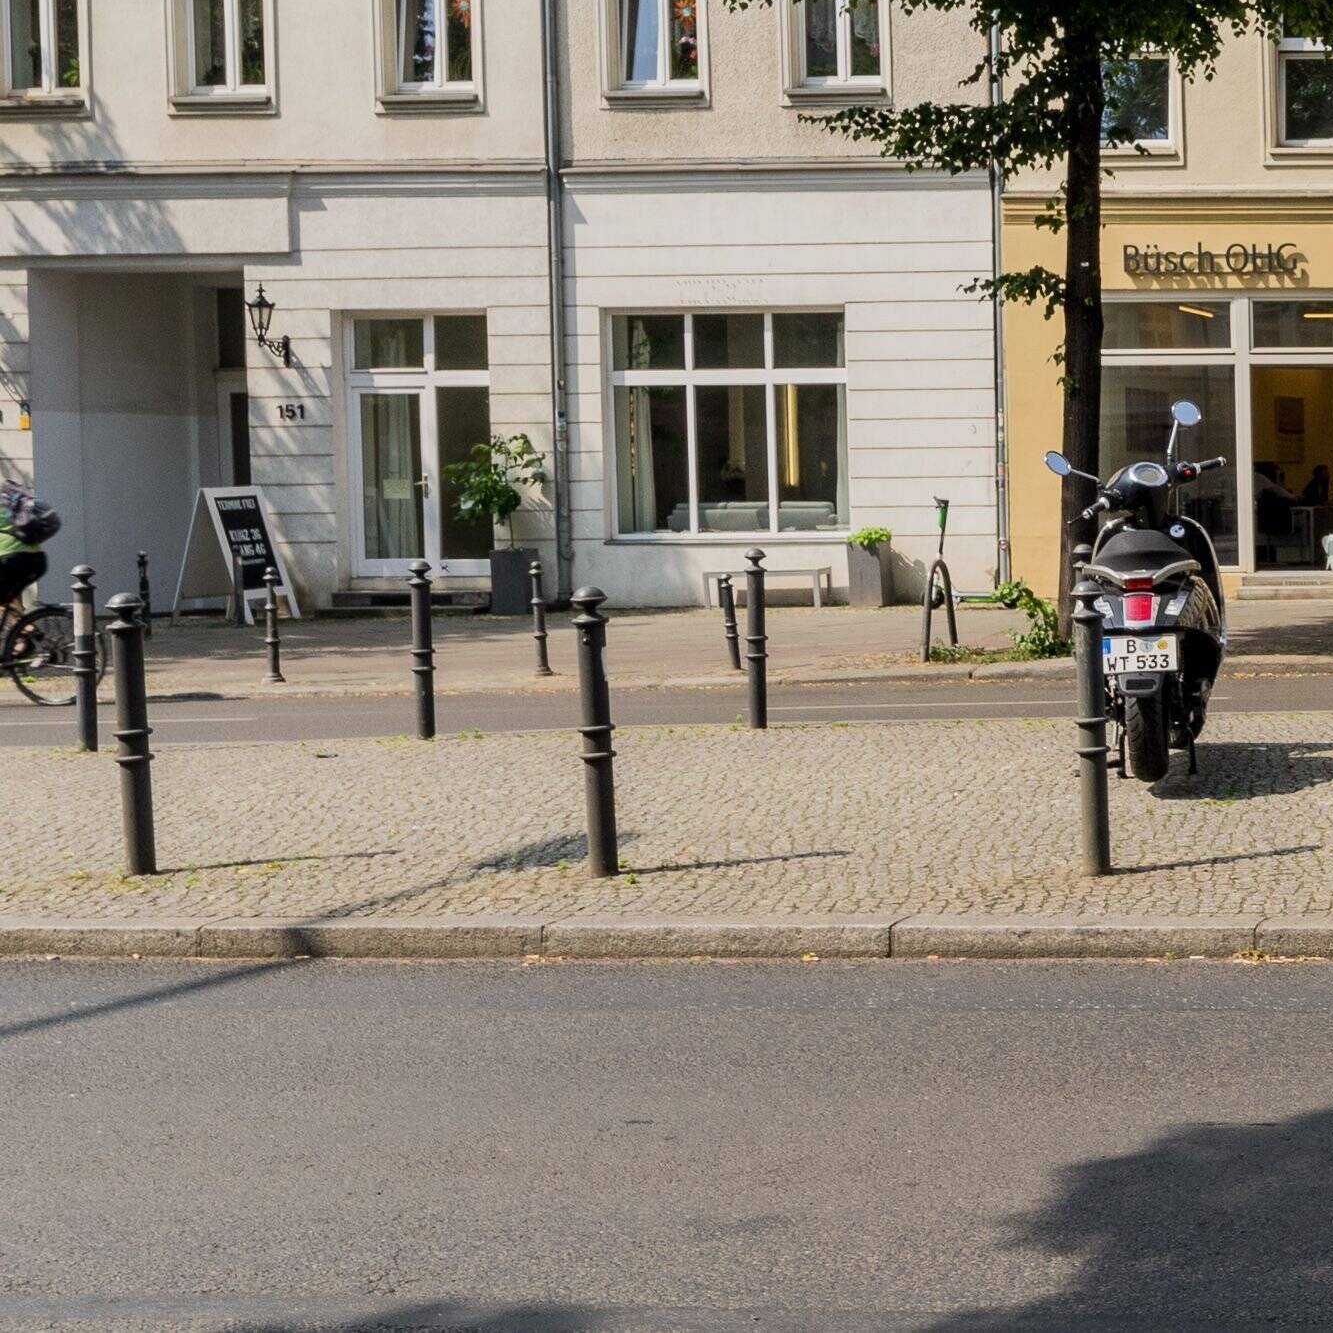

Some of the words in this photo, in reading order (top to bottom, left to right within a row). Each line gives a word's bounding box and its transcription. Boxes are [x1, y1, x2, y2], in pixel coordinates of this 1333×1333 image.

[1123, 241, 1215, 274] Büsch
[1225, 242, 1298, 273] OHG
[276, 404, 305, 420] 151
[1126, 639, 1137, 654] B
[1107, 656, 1129, 672] WT
[1136, 654, 1170, 670] 533
